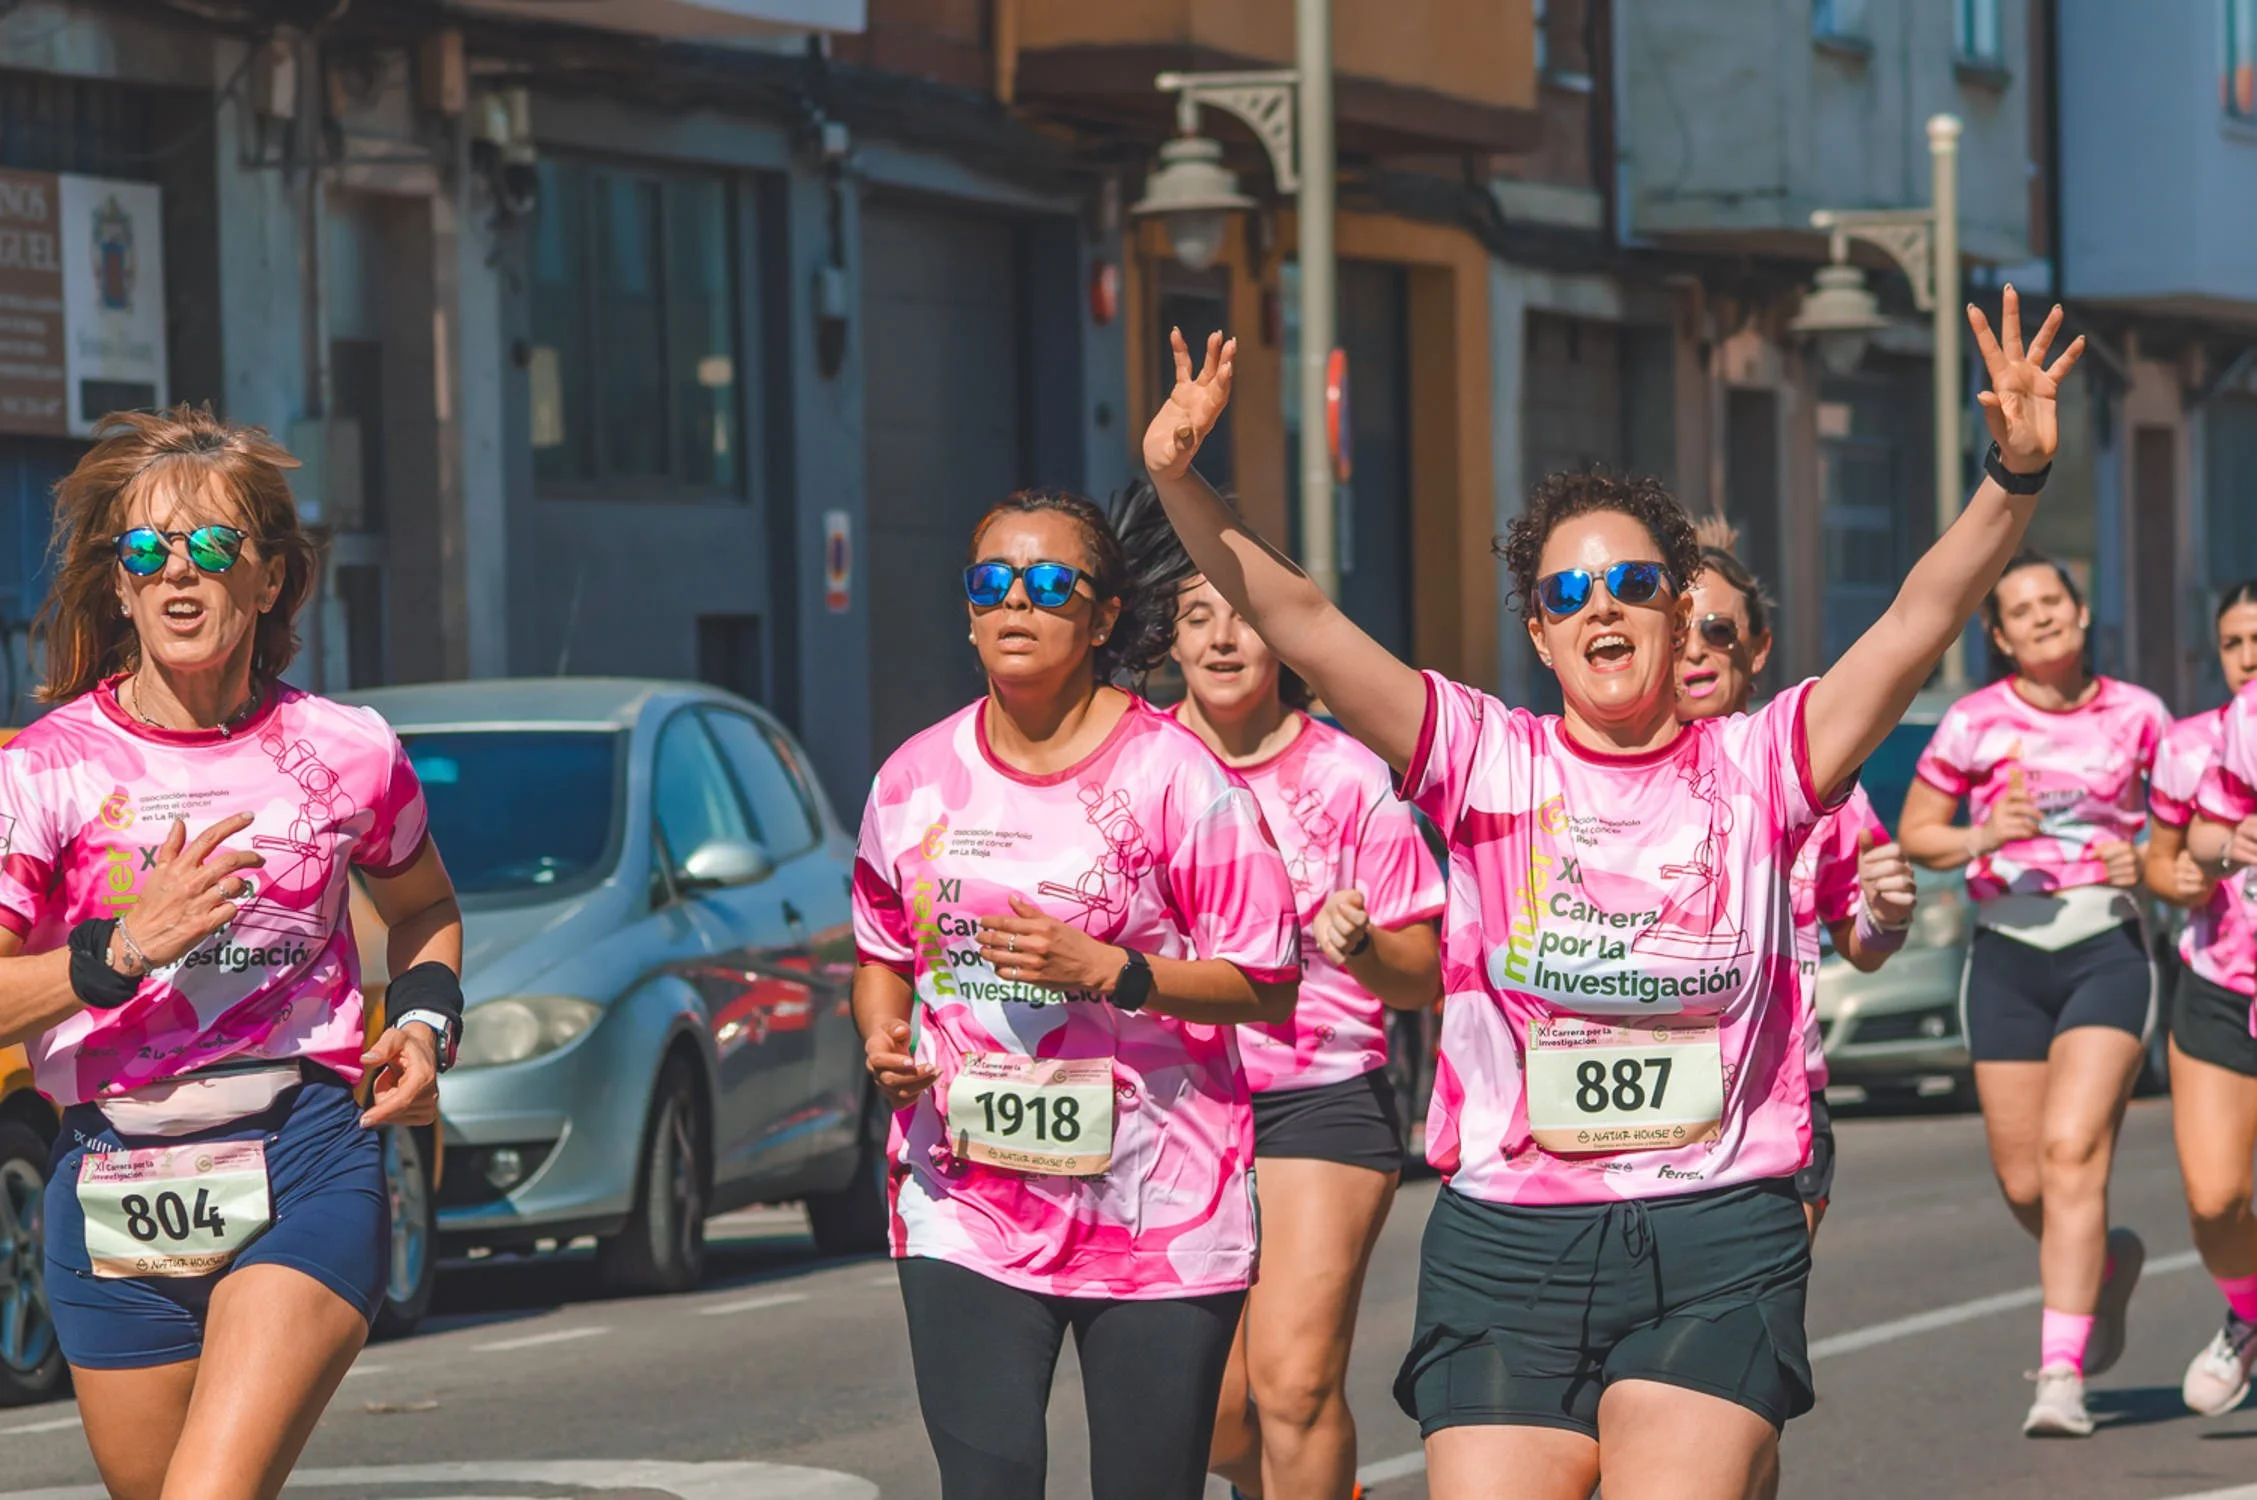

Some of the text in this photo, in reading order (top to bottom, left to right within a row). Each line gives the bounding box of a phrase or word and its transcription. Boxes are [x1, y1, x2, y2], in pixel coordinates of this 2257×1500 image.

[936, 878, 962, 903] XI
[1549, 892, 1660, 929] Carrera
[1538, 930, 1626, 960] por la
[1533, 961, 1742, 1004] Investigación
[1552, 1028, 1585, 1037] Carrera
[1586, 1028, 1601, 1037] por
[1575, 1057, 1673, 1113] 887
[974, 1091, 1081, 1143] 1918
[1593, 1129, 1670, 1141] NATUR HOUSE
[121, 1187, 226, 1242] 804
